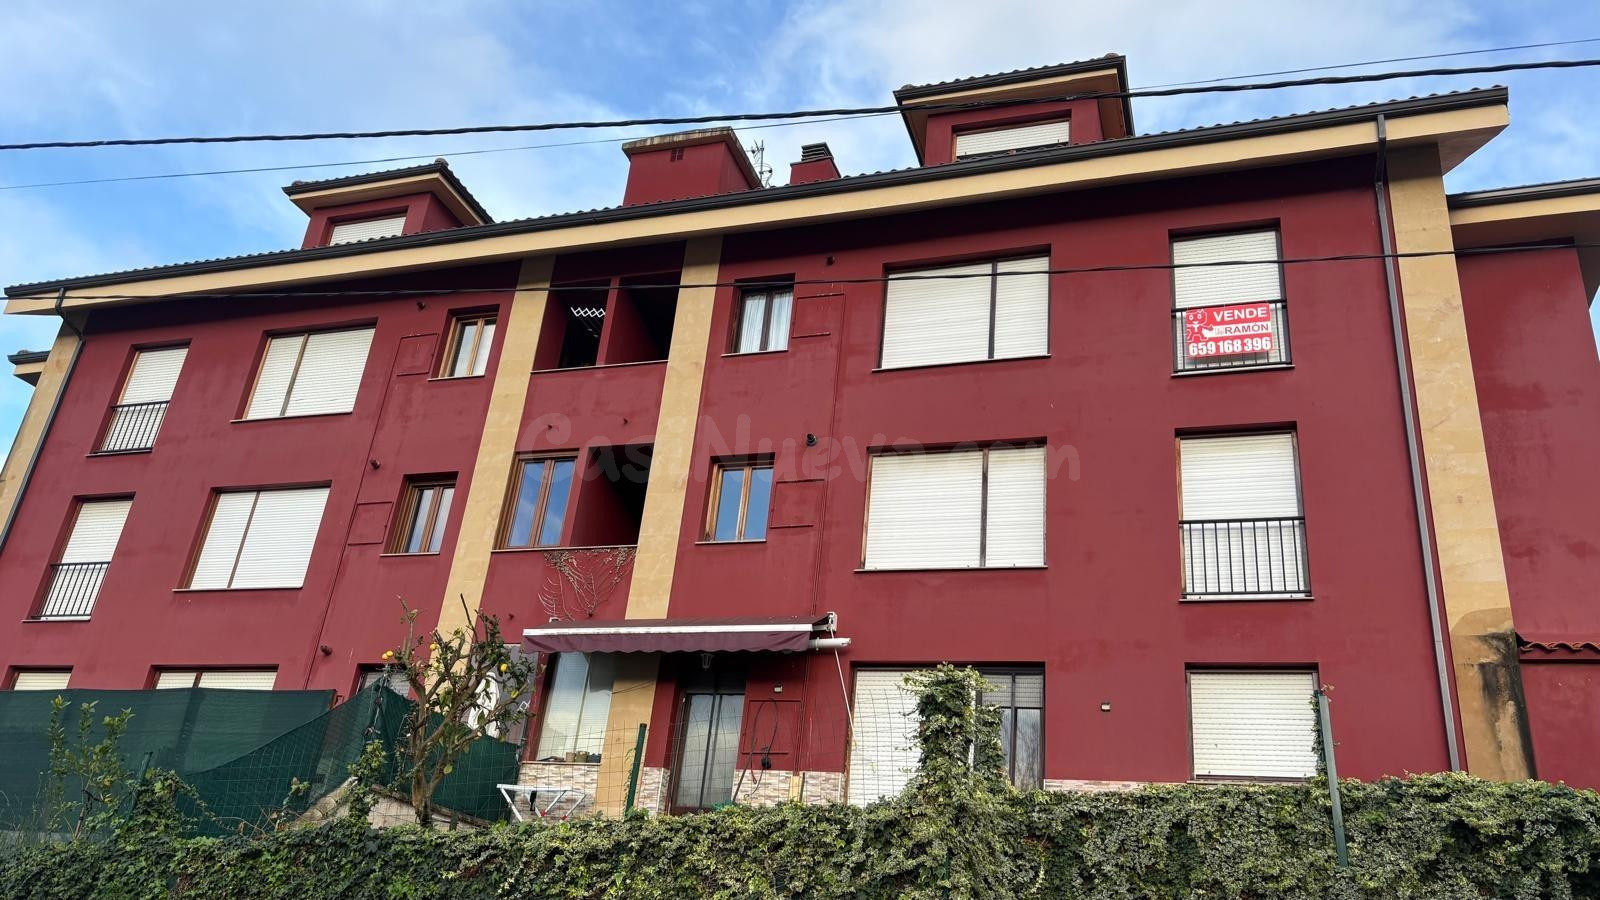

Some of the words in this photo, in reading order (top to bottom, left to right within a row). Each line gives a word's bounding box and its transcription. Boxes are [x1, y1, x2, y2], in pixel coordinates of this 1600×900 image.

[1213, 307, 1267, 321] VENDE
[1225, 323, 1268, 334] RAMÓN
[1189, 341, 1216, 355] 659
[1218, 339, 1242, 354] 168
[1244, 336, 1271, 351] 396
